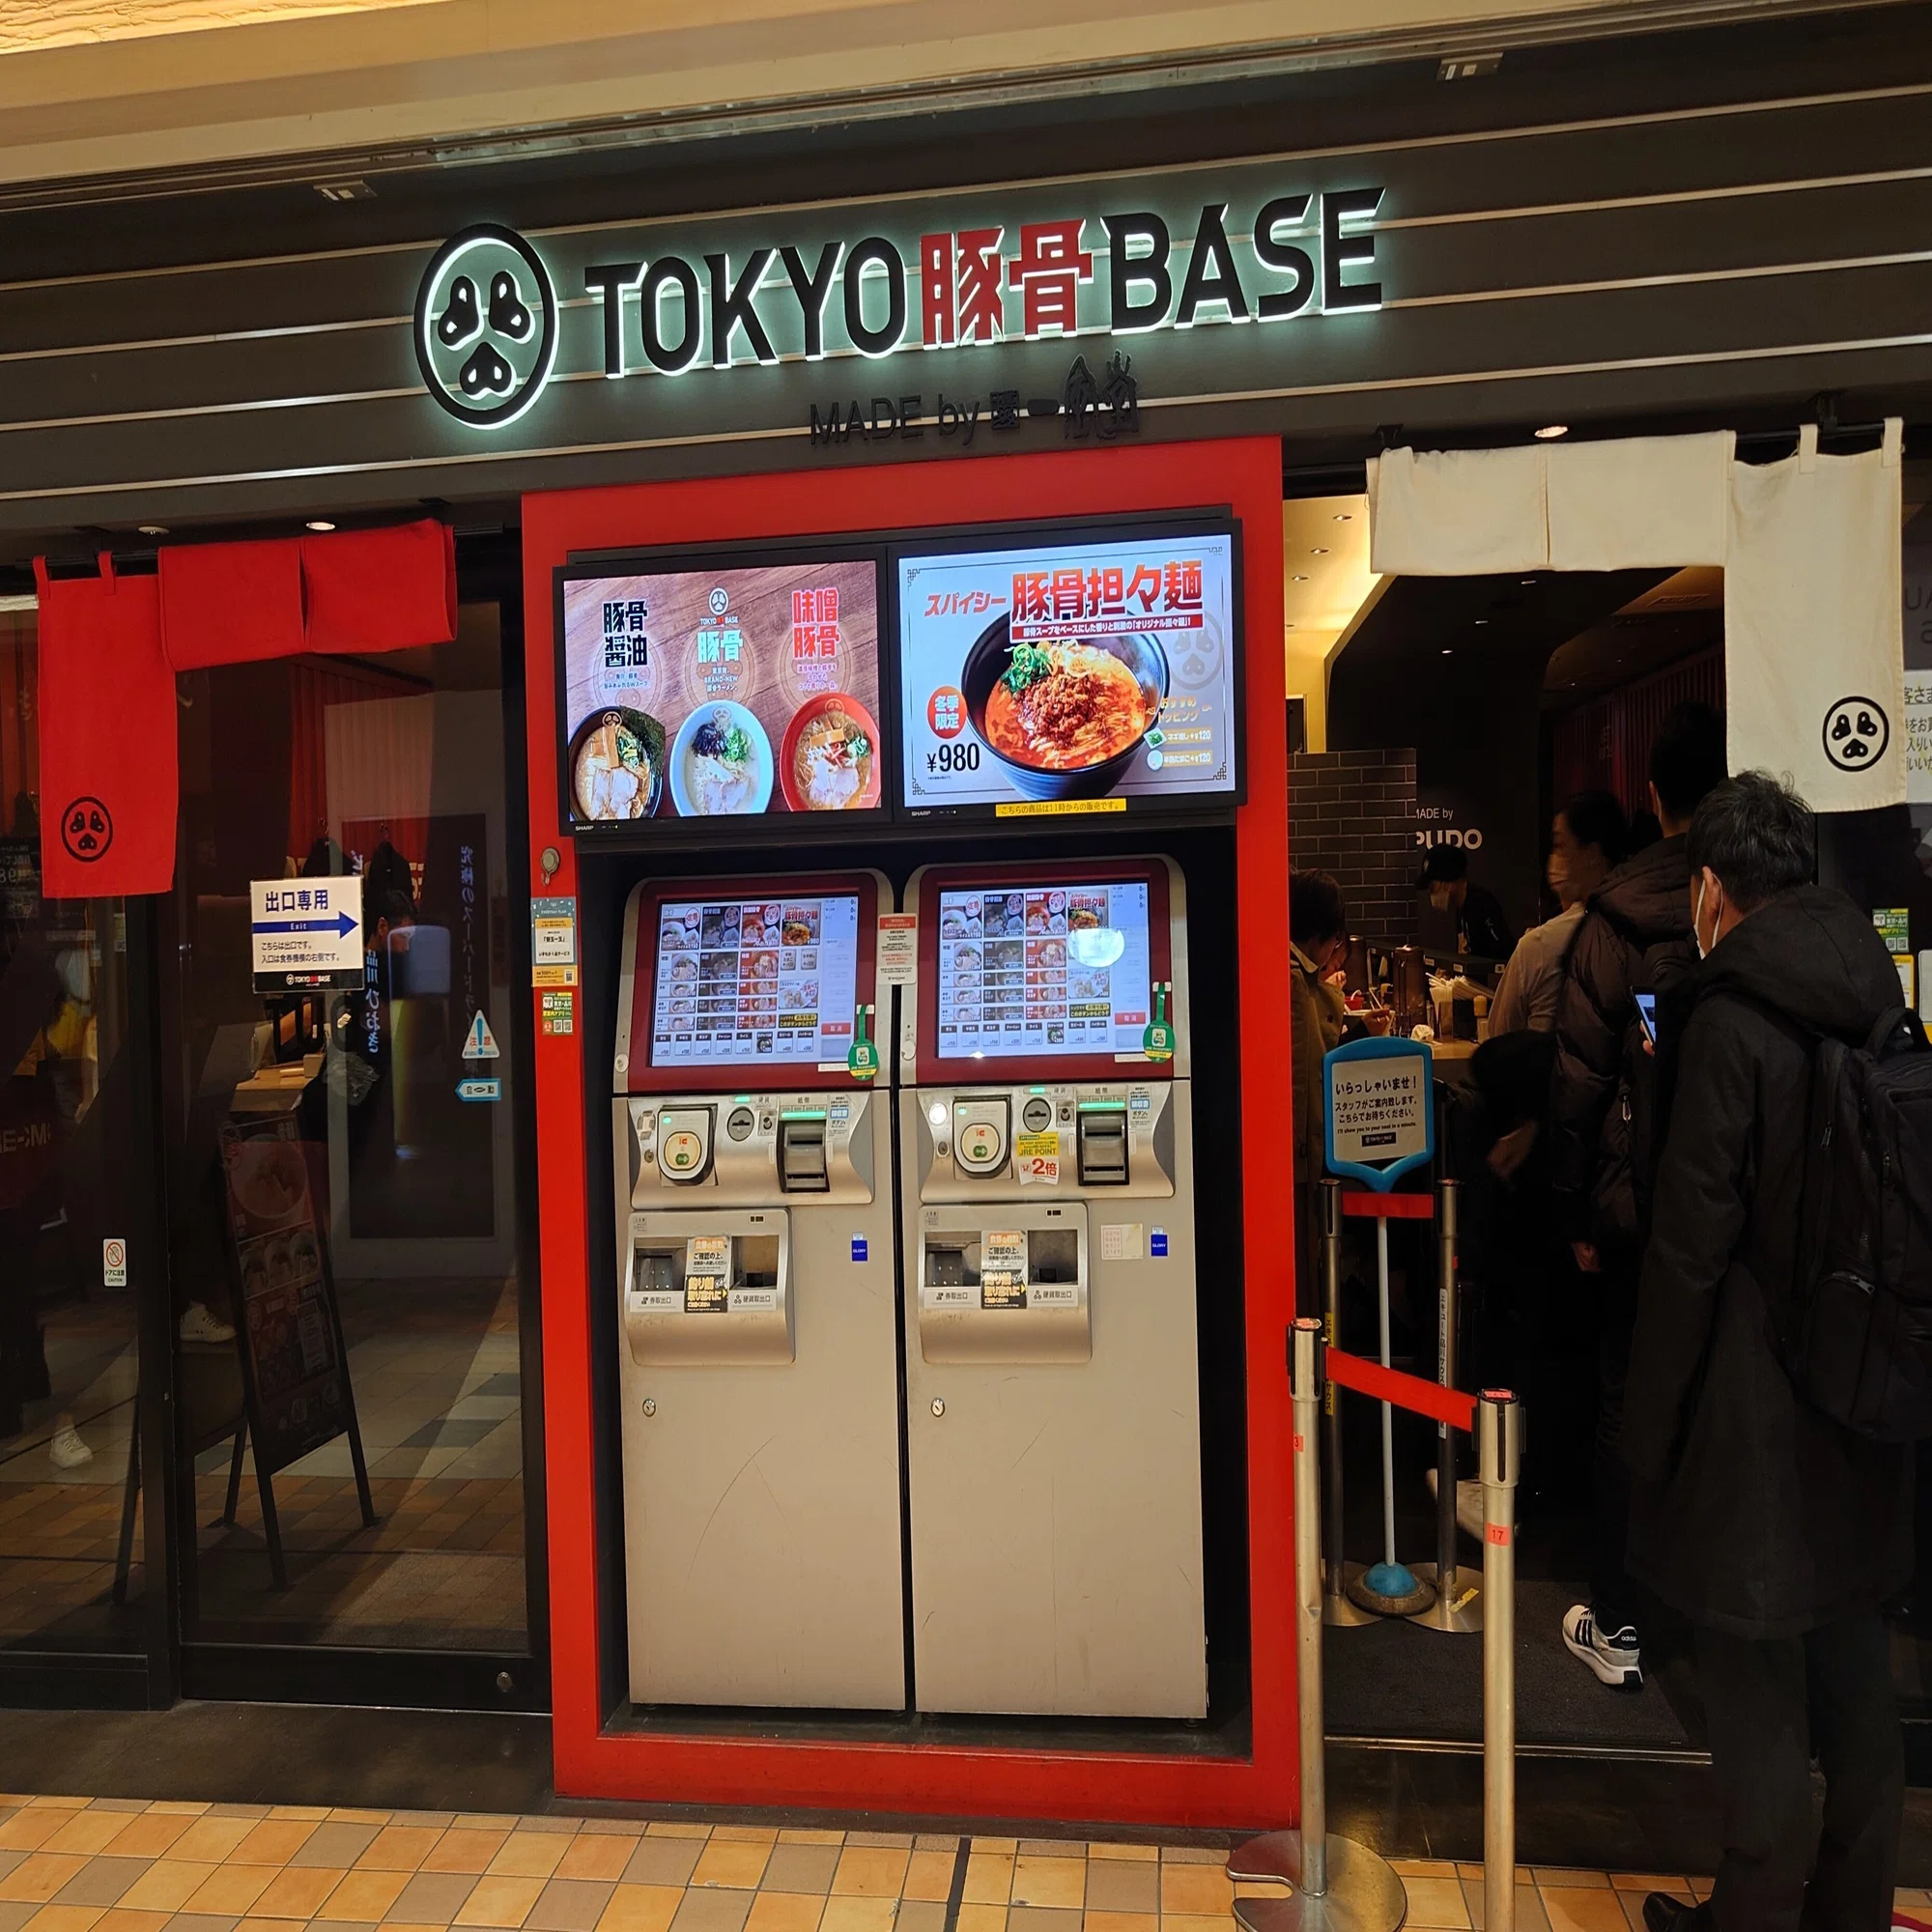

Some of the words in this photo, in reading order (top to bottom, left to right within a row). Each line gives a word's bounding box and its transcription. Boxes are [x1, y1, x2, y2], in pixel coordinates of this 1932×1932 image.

[810, 394, 923, 445] MADE
[938, 393, 980, 445] by
[1010, 560, 1205, 622] 豚骨担々麺
[792, 587, 838, 624] 味噌
[923, 590, 1008, 617] スパイシー
[603, 600, 648, 634] 豚骨
[604, 634, 648, 668] 醤油
[696, 630, 743, 664] 豚骨
[793, 624, 840, 659] 豚骨
[934, 694, 959, 712] 冬季
[934, 712, 960, 730] 限定
[926, 742, 980, 773] ¥980
[1442, 808, 1454, 821] by
[265, 889, 329, 913] 出口専用
[261, 941, 312, 952] こちらは出口です。
[1335, 1075, 1417, 1095] いらっしゃいませ！
[1335, 1095, 1417, 1112] スタッフがご案内致します。
[1339, 1109, 1414, 1123] こちらでお待ちください。
[1032, 1157, 1058, 1177] 2倍
[1492, 1529, 1504, 1541] 17
